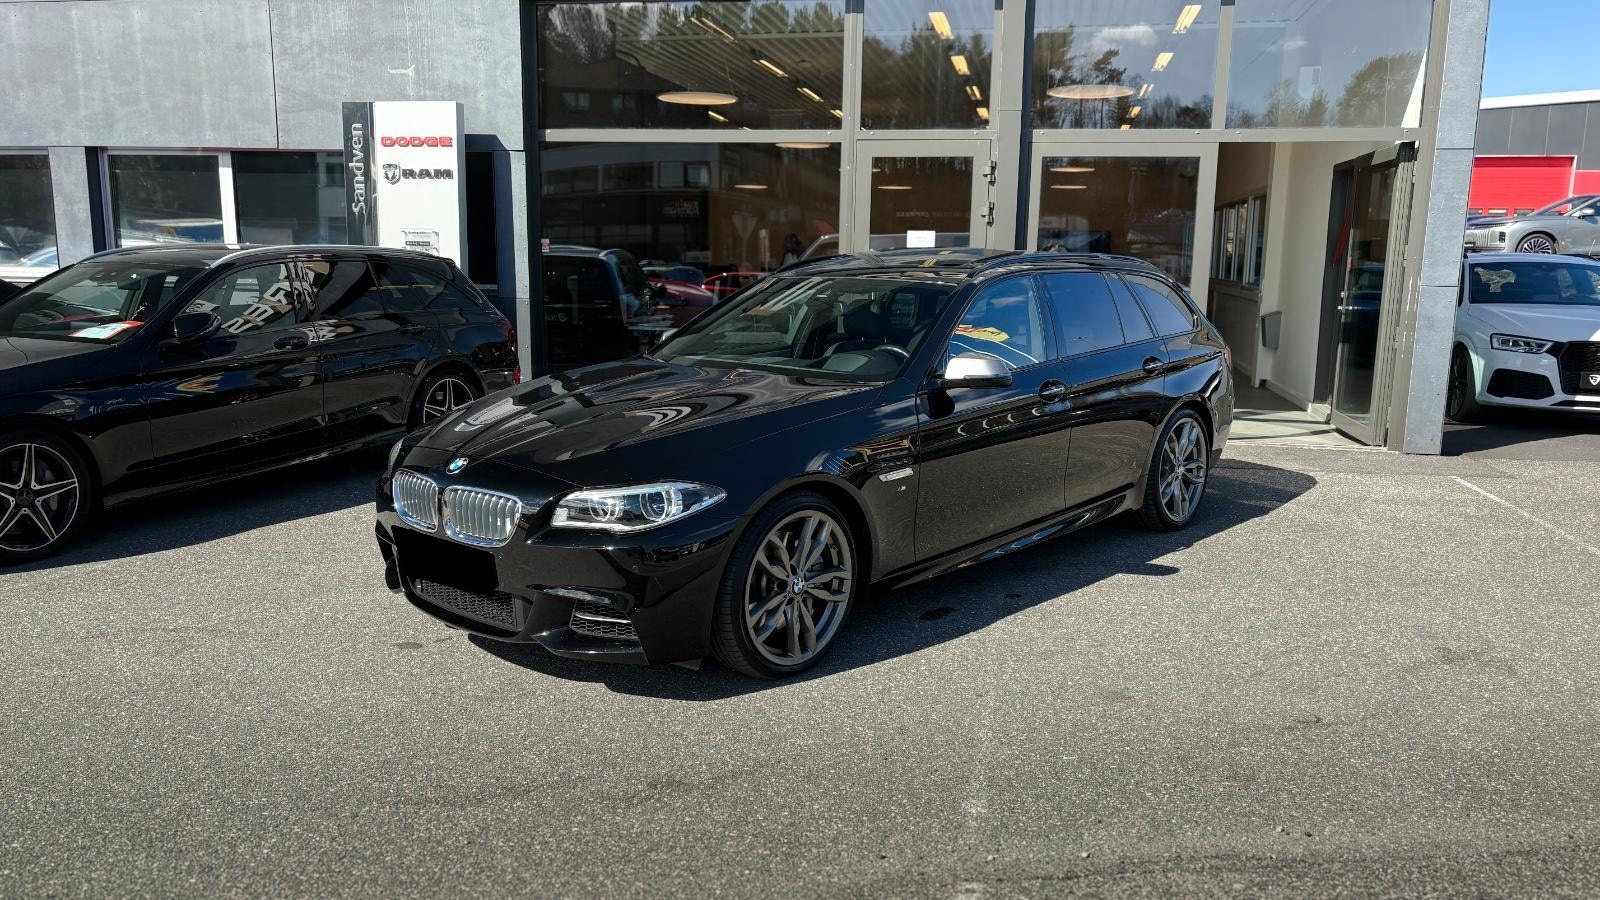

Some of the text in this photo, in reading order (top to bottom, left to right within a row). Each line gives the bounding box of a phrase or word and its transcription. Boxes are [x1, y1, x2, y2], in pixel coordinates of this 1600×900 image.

[381, 136, 453, 147] DODGE
[349, 123, 366, 215] Sandven
[402, 169, 453, 179] RAM
